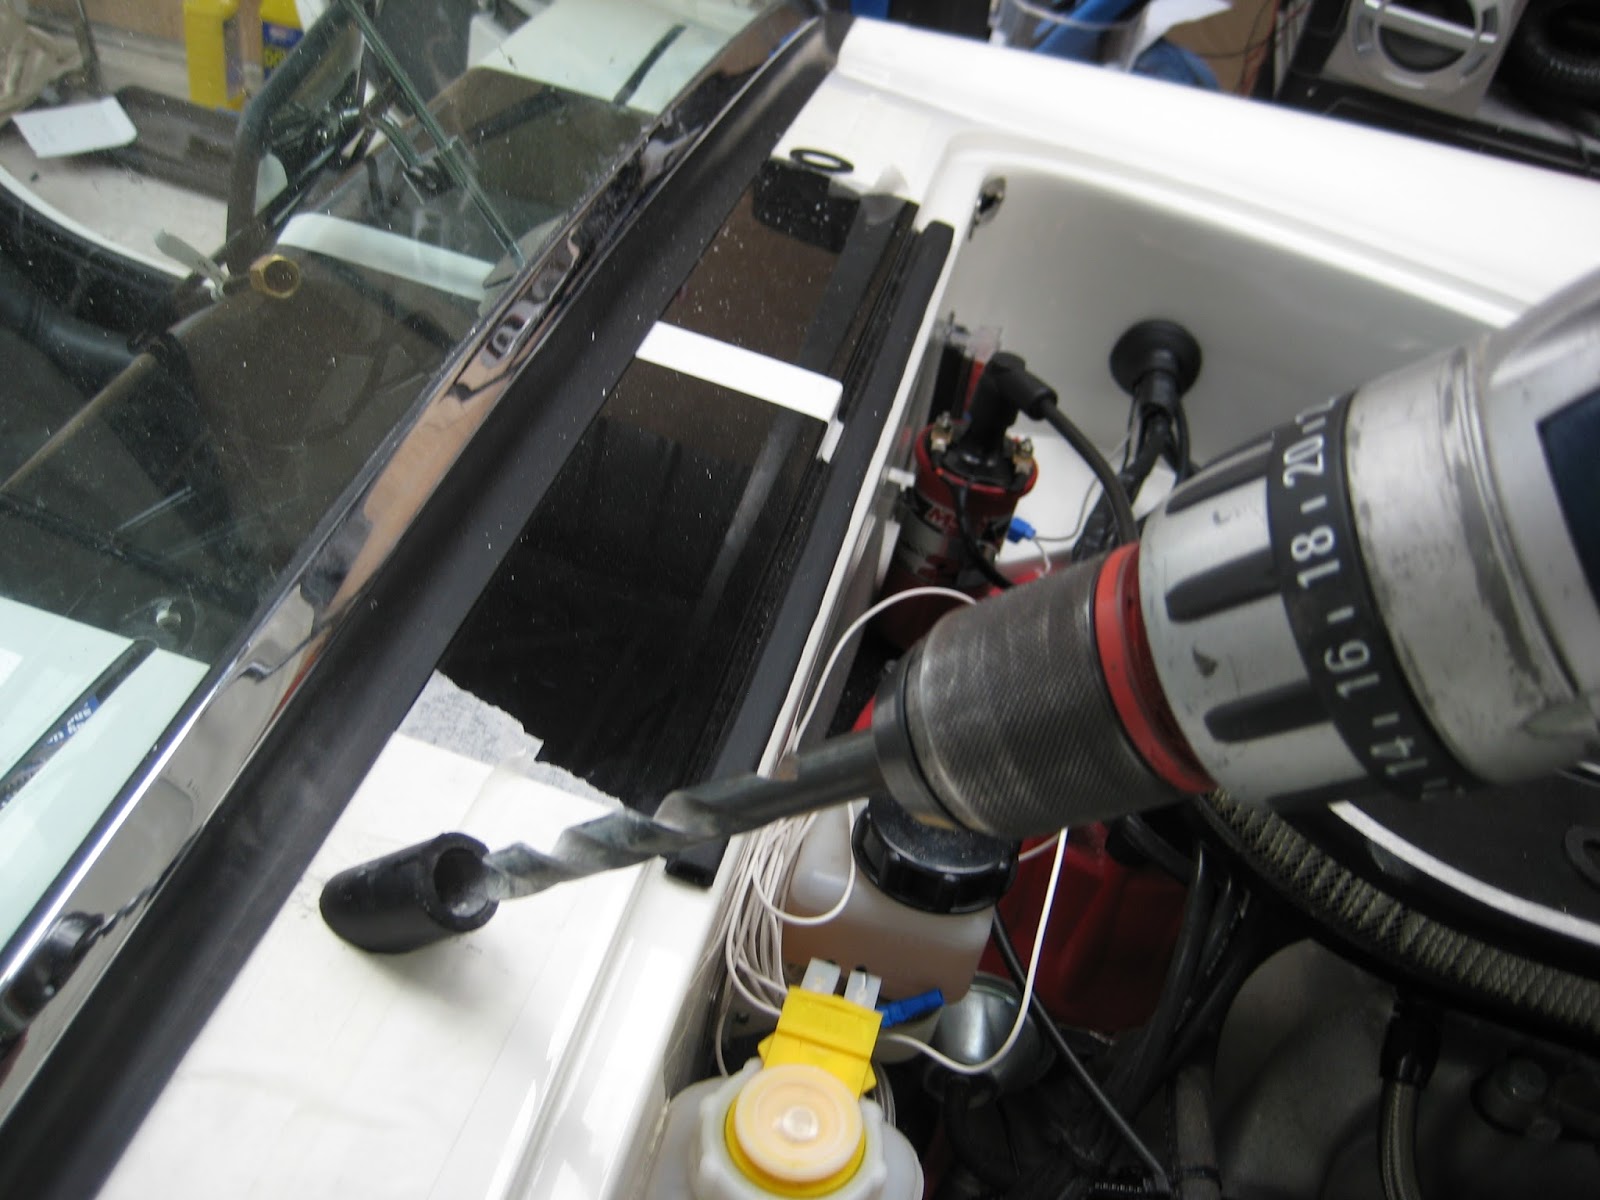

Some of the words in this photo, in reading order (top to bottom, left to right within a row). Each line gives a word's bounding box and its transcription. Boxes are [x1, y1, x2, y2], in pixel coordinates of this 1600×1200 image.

[1283, 433, 1324, 488] 20
[1290, 524, 1341, 589] 18
[1324, 638, 1380, 698] 16
[1370, 735, 1428, 777] 14
